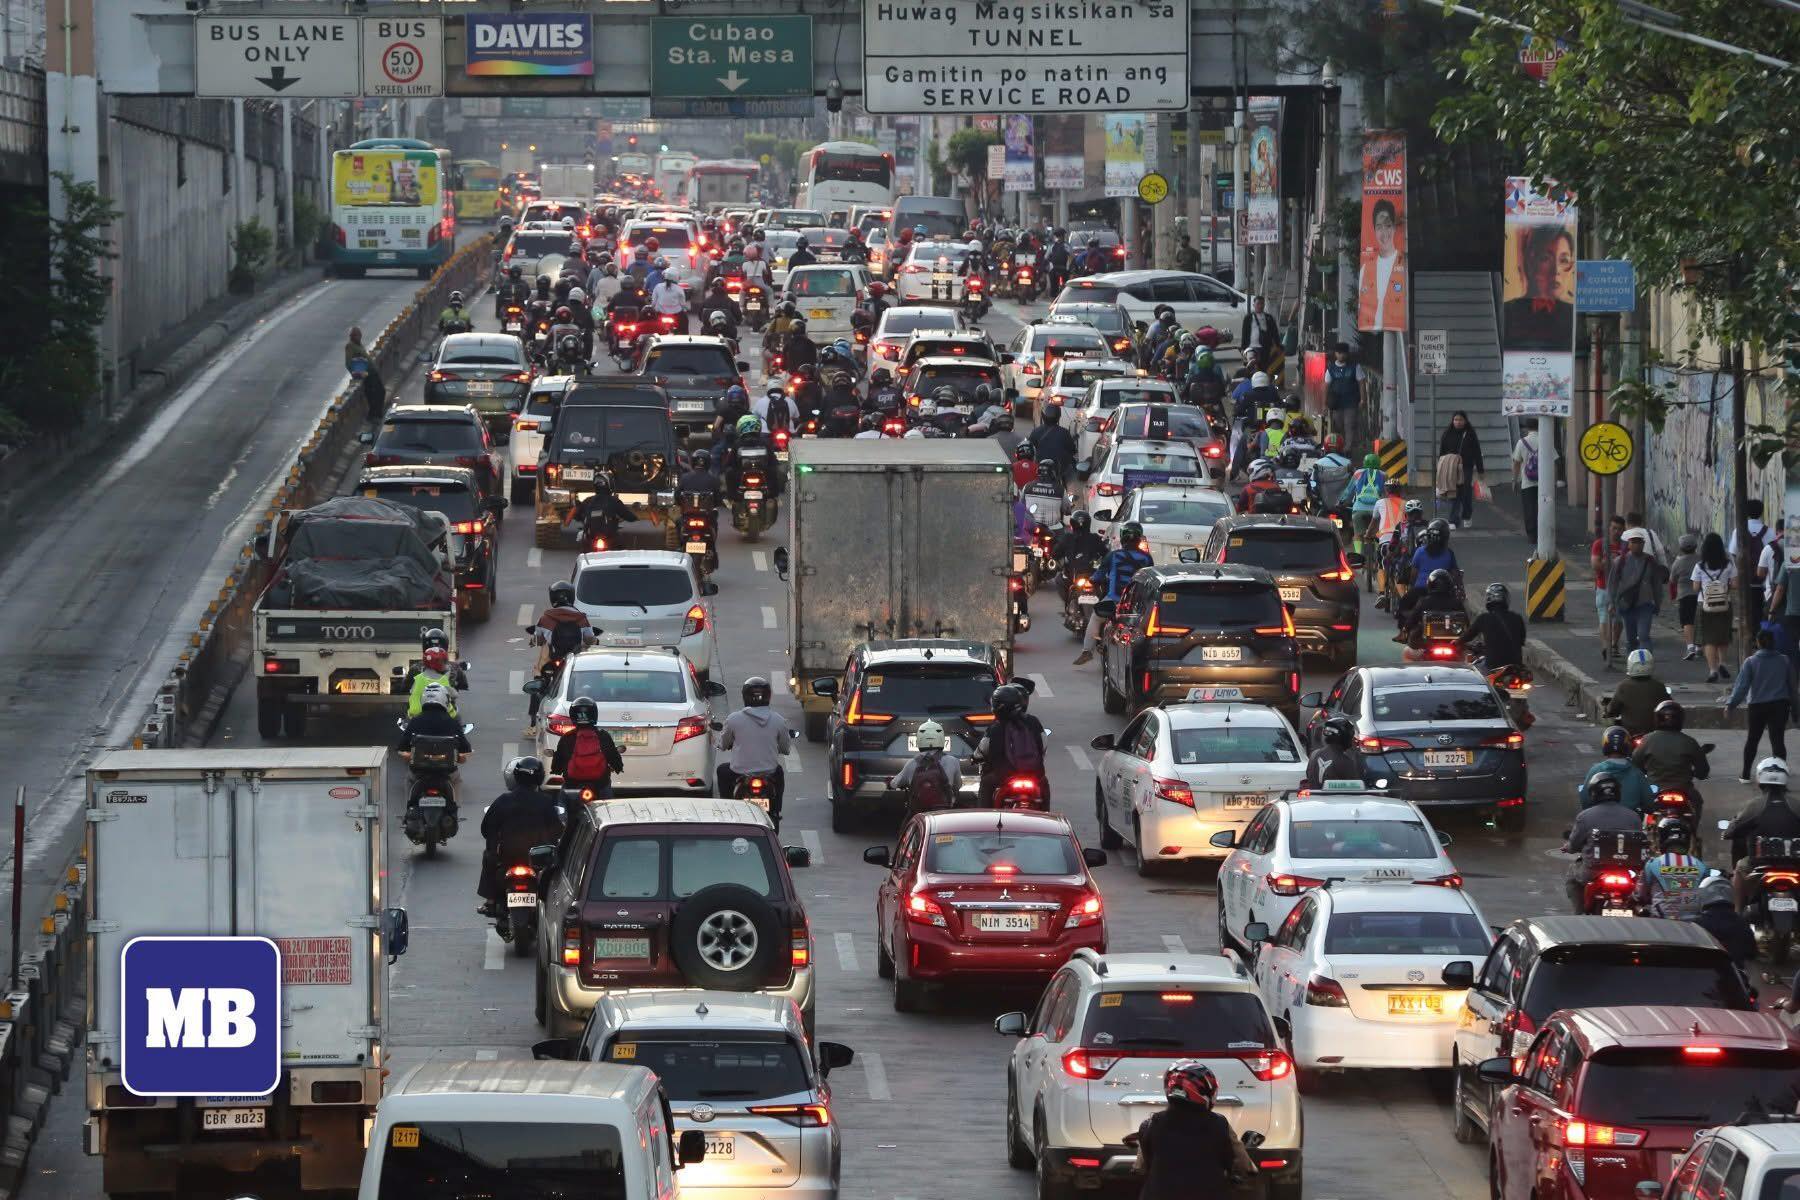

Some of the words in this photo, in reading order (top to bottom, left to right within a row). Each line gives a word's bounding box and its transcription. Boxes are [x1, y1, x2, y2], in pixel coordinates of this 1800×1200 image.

[878, 3, 957, 25] Huwag
[975, 0, 1133, 23] Magsiksikan
[1149, 4, 1174, 18] sa
[210, 25, 260, 41] BUS
[279, 25, 345, 41] LANE
[377, 22, 426, 38] BUS
[475, 24, 584, 48] DAVIES
[688, 24, 774, 41] Cubao
[968, 29, 1082, 46] TUNNEL
[244, 46, 311, 62] ONLY
[390, 51, 415, 66] 50
[668, 47, 716, 64] Sta.
[728, 46, 794, 63] Mesa
[391, 66, 414, 75] MAX
[885, 65, 983, 83] Gamitin
[1001, 68, 1027, 86] po
[1044, 64, 1108, 82] natin
[1124, 65, 1167, 84] ang
[374, 84, 404, 94] SPEED
[407, 84, 433, 94] LIMIT
[923, 88, 1045, 106] SERVICE
[1059, 87, 1131, 105] ROAD
[1374, 169, 1402, 186] CWS
[321, 625, 375, 640] TOTO
[1203, 650, 1218, 658] NID
[1445, 754, 1466, 763] 2275
[981, 917, 1000, 928] NIM
[1005, 917, 1030, 928] 3514
[205, 1113, 227, 1125] CBR
[234, 1112, 263, 1124] 8023
[704, 1142, 733, 1154] 2128
